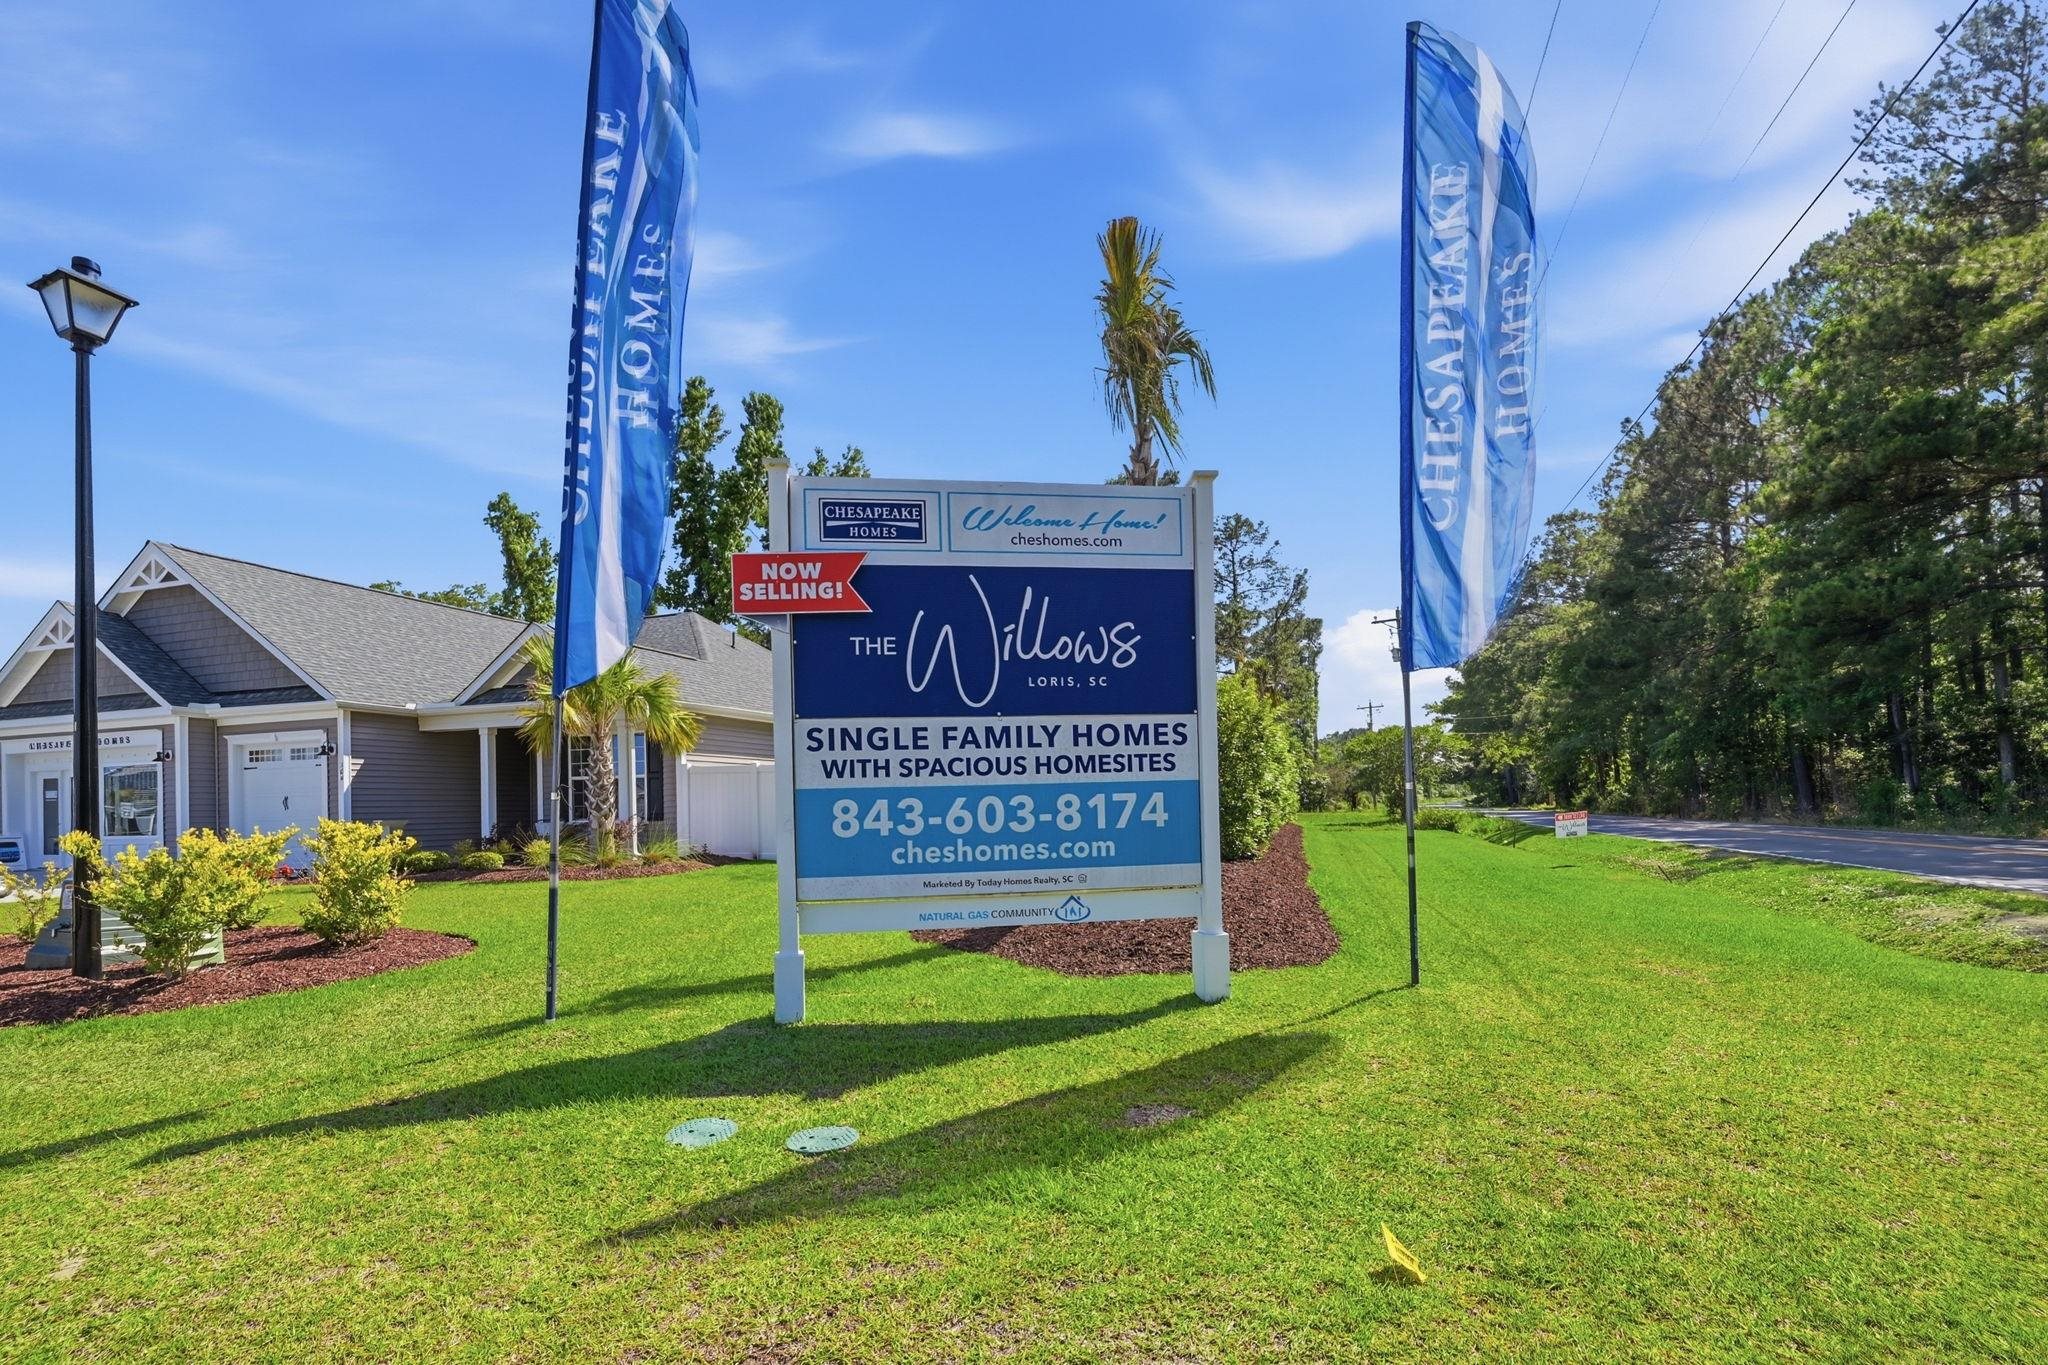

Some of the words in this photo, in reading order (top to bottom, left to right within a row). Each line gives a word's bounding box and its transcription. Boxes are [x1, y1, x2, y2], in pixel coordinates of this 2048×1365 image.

[614, 223, 666, 429] HOMES
[1419, 161, 1469, 531] CHESAPEAKE
[1493, 252, 1532, 438] HOMES
[824, 506, 921, 520] CHESAPEAKE
[962, 504, 1074, 532] Welcome
[1078, 510, 1168, 535] Home!
[849, 526, 897, 538] HOMES
[1010, 532, 1123, 548] cheshomes.com
[761, 562, 822, 580] NOW
[739, 581, 843, 600] SELLING!
[849, 636, 897, 656] THE
[906, 574, 1142, 708] Willows
[1028, 676, 1081, 688] LORIS,
[1088, 676, 1108, 687] SC
[806, 726, 929, 752] SINGLE
[943, 724, 1062, 750] FAMILY
[1072, 722, 1189, 748] HOMES
[820, 758, 891, 779] WITH
[898, 755, 1027, 778] SPACIOUS
[1035, 752, 1176, 775] HOMESITES
[831, 791, 1169, 838] 843-603-8174
[891, 837, 1116, 865] cheshomes.com
[923, 880, 963, 889] Marketed
[965, 880, 975, 889] By
[977, 878, 1002, 888] Today
[1004, 877, 1032, 886] Homes
[1062, 875, 1074, 883] SC
[919, 911, 965, 922] NATURAL
[968, 910, 989, 920] GAS
[991, 907, 1054, 919] COMMUNITY
